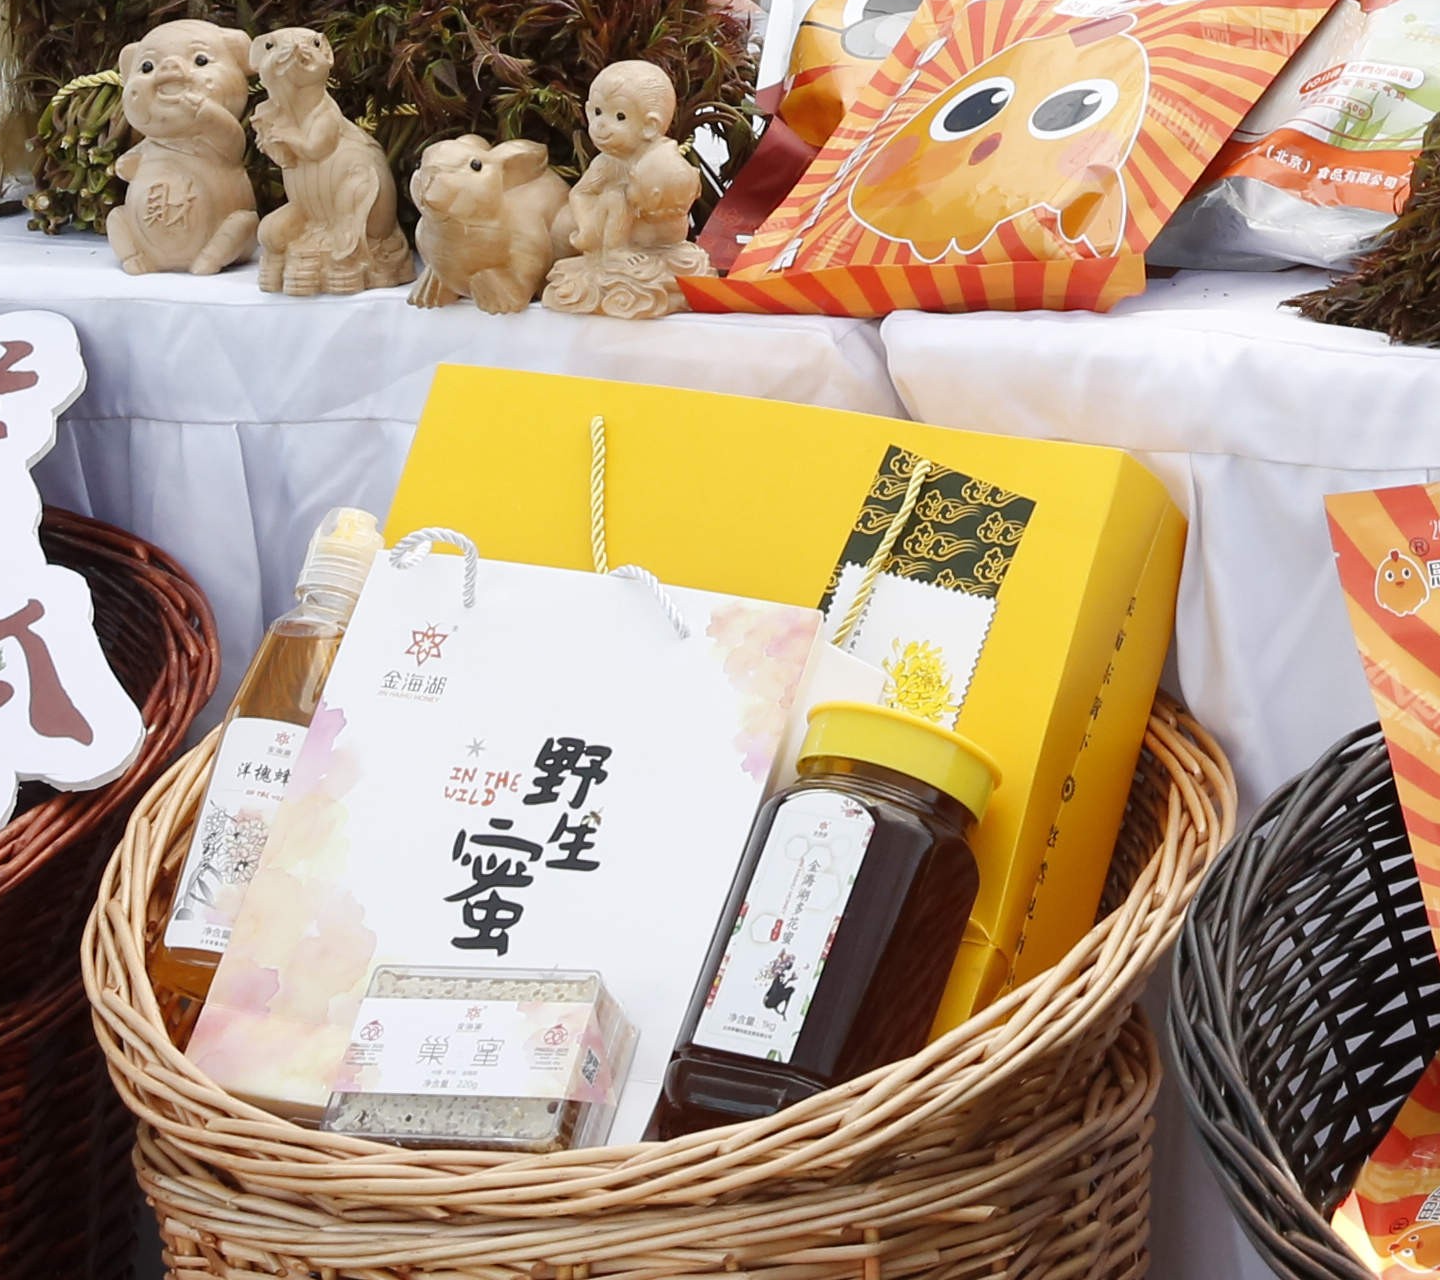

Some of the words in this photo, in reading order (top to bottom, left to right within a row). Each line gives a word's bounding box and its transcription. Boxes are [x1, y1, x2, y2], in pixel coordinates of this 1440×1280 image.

[380, 669, 448, 696] 金海湖
[449, 766, 478, 785] IN
[484, 770, 523, 793] THE
[443, 786, 497, 807] WILD
